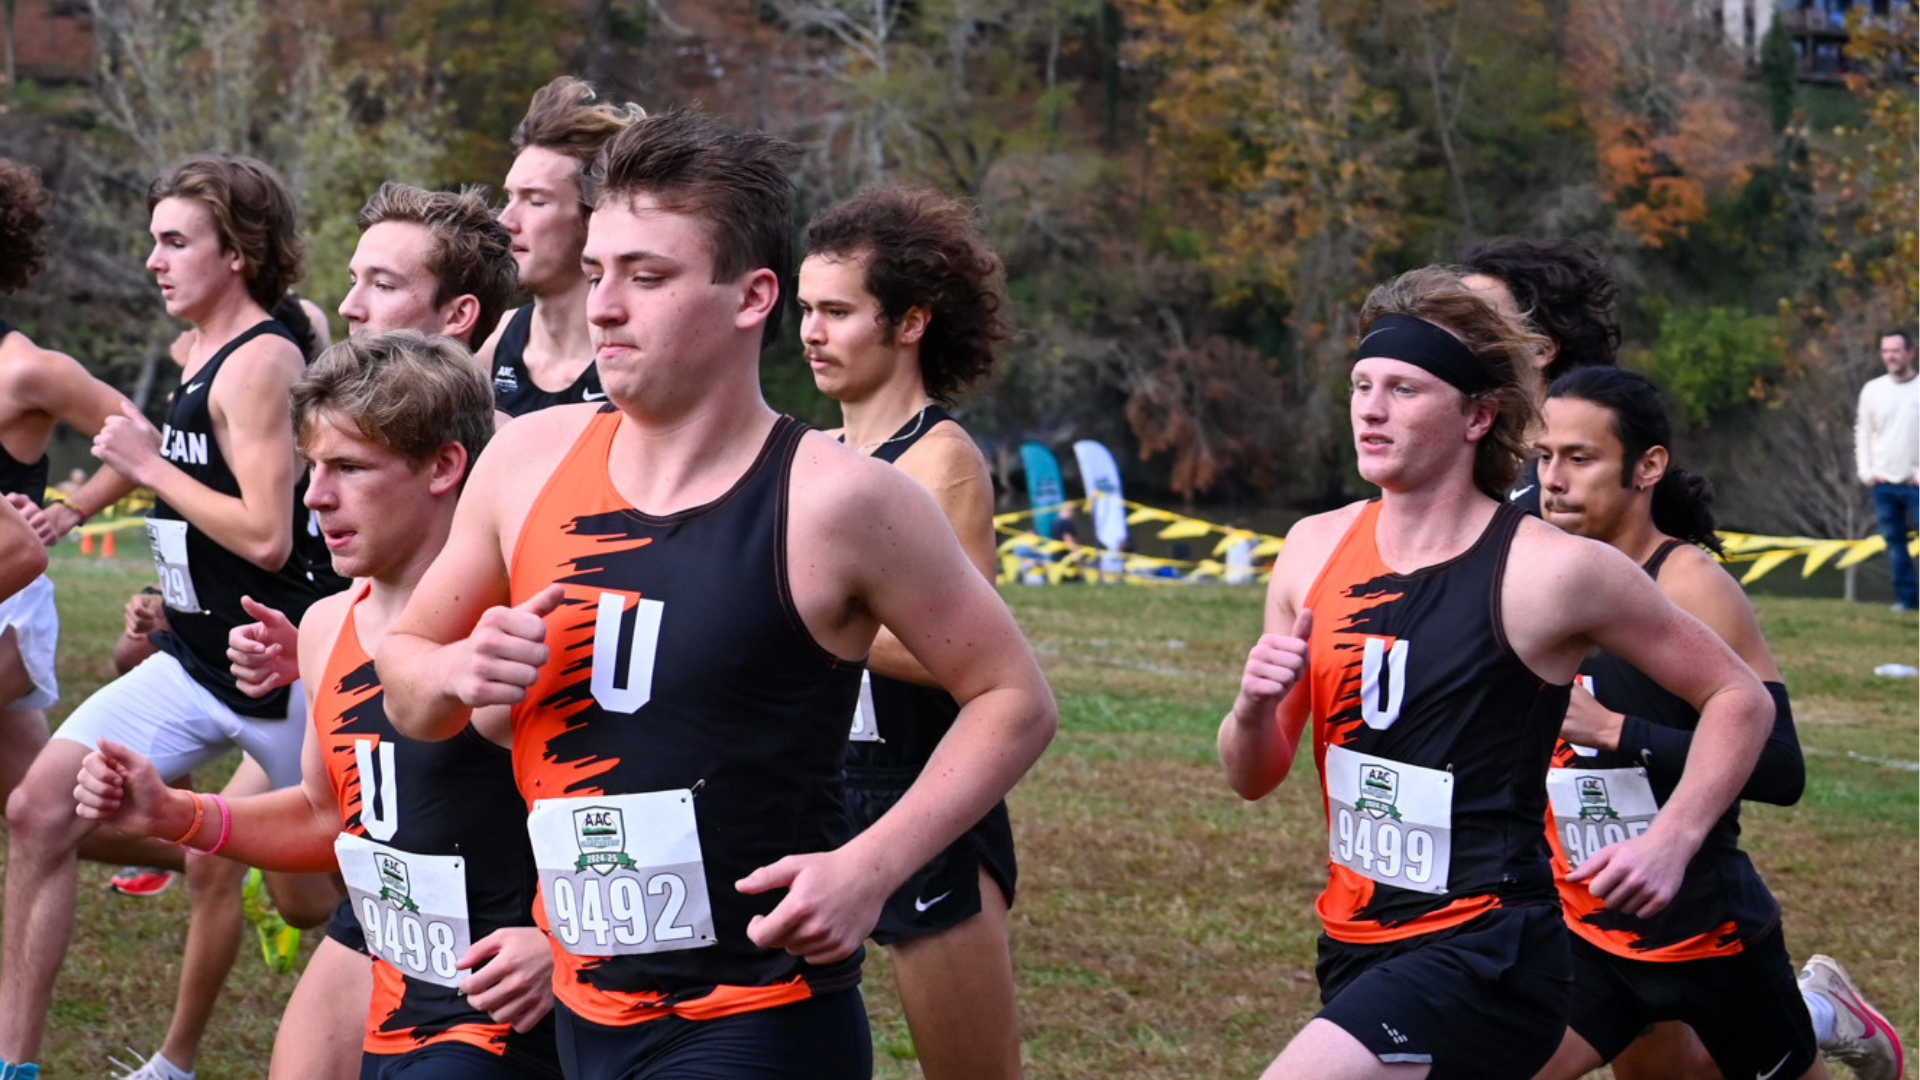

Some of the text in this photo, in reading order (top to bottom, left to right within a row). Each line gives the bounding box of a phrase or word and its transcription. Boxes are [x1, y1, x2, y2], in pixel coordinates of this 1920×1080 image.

[590, 592, 665, 715] U
[1361, 637, 1409, 731] U
[355, 739, 398, 842] U
[585, 812, 613, 827] AAC
[586, 853, 618, 864] 2024-25
[1338, 808, 1435, 884] 9499
[362, 897, 458, 979] 9498
[553, 872, 694, 946] 9492
